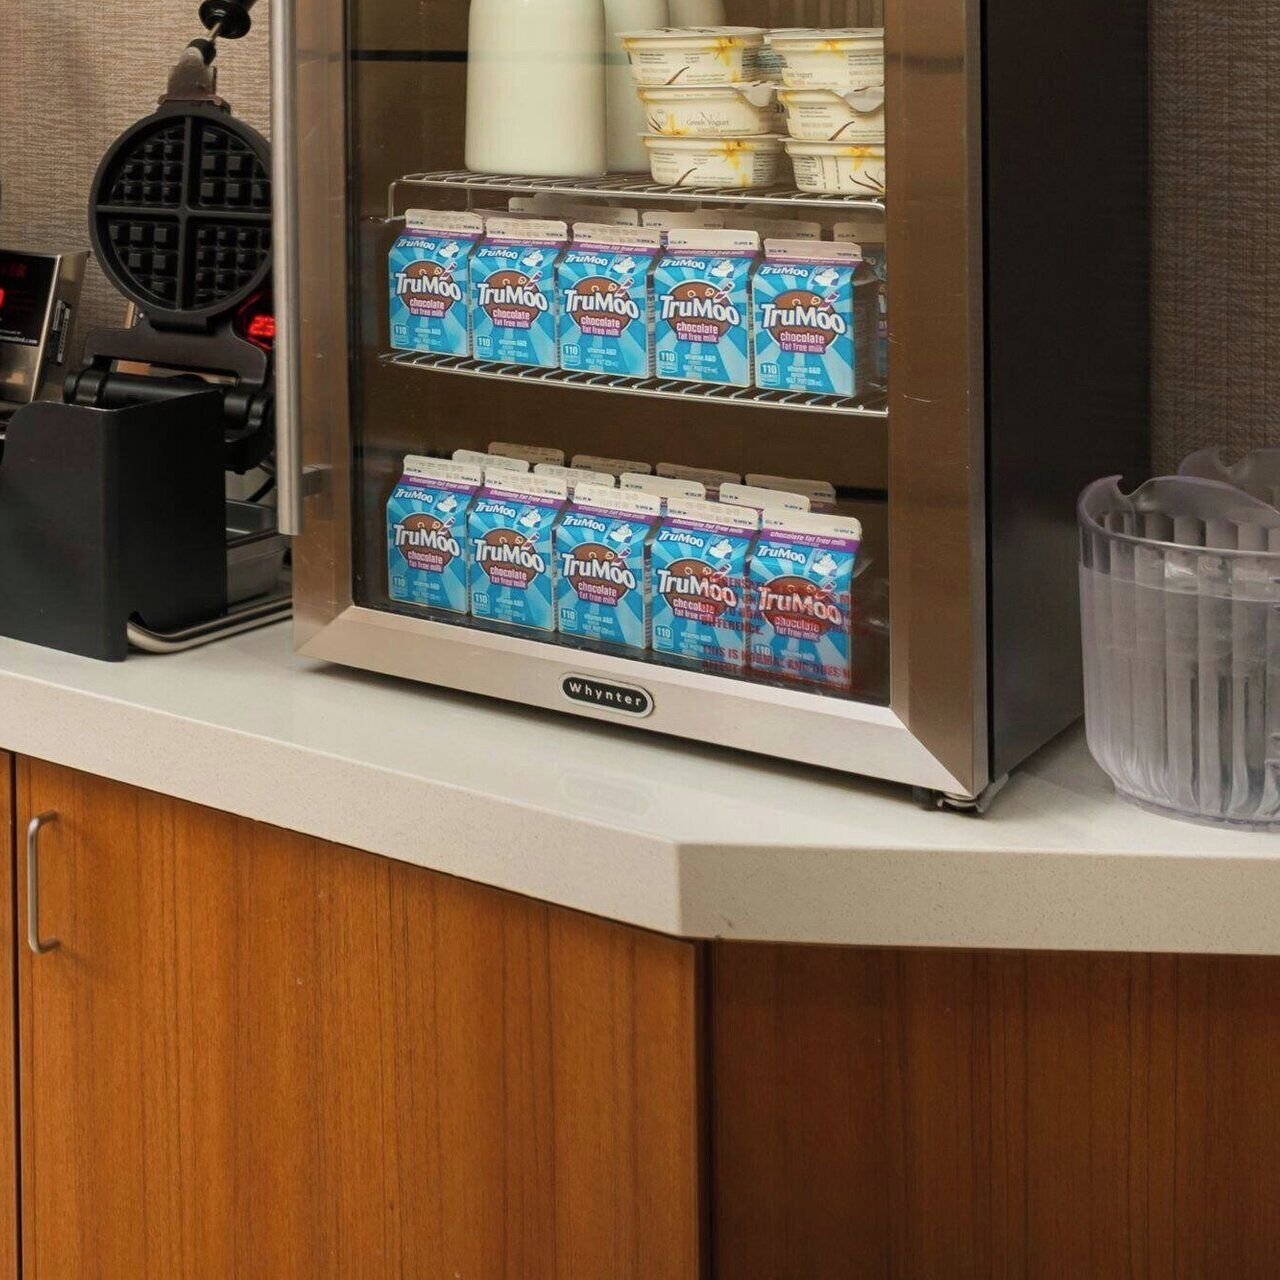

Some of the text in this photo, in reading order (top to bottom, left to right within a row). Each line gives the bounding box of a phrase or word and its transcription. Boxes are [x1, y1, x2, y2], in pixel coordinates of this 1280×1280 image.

[396, 238, 436, 250] TruMoo
[478, 249, 518, 259] TruMoo
[565, 254, 608, 266] TruMoo
[661, 258, 705, 270] TruMoo
[760, 267, 809, 277] TruMoo
[395, 272, 462, 301] TruMoo
[409, 297, 445, 310] chocolate
[476, 283, 549, 312] TruMoo
[564, 289, 639, 319] TruMoo
[493, 308, 530, 320] chocolate
[660, 295, 740, 326] TruMoo
[494, 318, 503, 326] fat
[503, 319, 516, 327] free
[580, 315, 621, 327] chocolate
[760, 303, 846, 334] TruMoo
[395, 326, 407, 334] 110
[582, 326, 619, 337] fat free milk
[676, 321, 718, 334] chocolate
[478, 336, 490, 346] 110
[678, 332, 717, 343] fat free milk
[780, 331, 825, 344] chocolate
[565, 346, 578, 355] 110
[781, 342, 824, 353] fat free milk
[661, 352, 675, 362] 110
[762, 364, 777, 374] 110
[395, 488, 434, 504] TruMoo
[476, 502, 516, 518] TruMoo
[563, 515, 606, 533] TruMoo
[393, 524, 461, 557] TruMoo
[659, 530, 704, 548] TruMoo
[770, 531, 804, 542] chocolate
[816, 537, 830, 545] free
[831, 539, 846, 547] milk
[408, 550, 443, 564] chocolate
[474, 538, 545, 572] TruMoo
[756, 545, 806, 564] TruMoo
[490, 565, 527, 580] chocolate
[562, 553, 636, 589] TruMoo
[394, 578, 405, 587] 110
[578, 581, 617, 597] chocolate
[657, 570, 738, 607] TruMoo
[475, 594, 487, 604] 110
[579, 591, 616, 605] fat free milk
[673, 597, 715, 615] chocolate
[758, 586, 845, 624] TruMoo
[562, 610, 575, 621] 110
[774, 614, 820, 632] chocolate
[657, 626, 671, 637] 110
[755, 645, 771, 655] 110
[568, 681, 642, 706] Whynter
